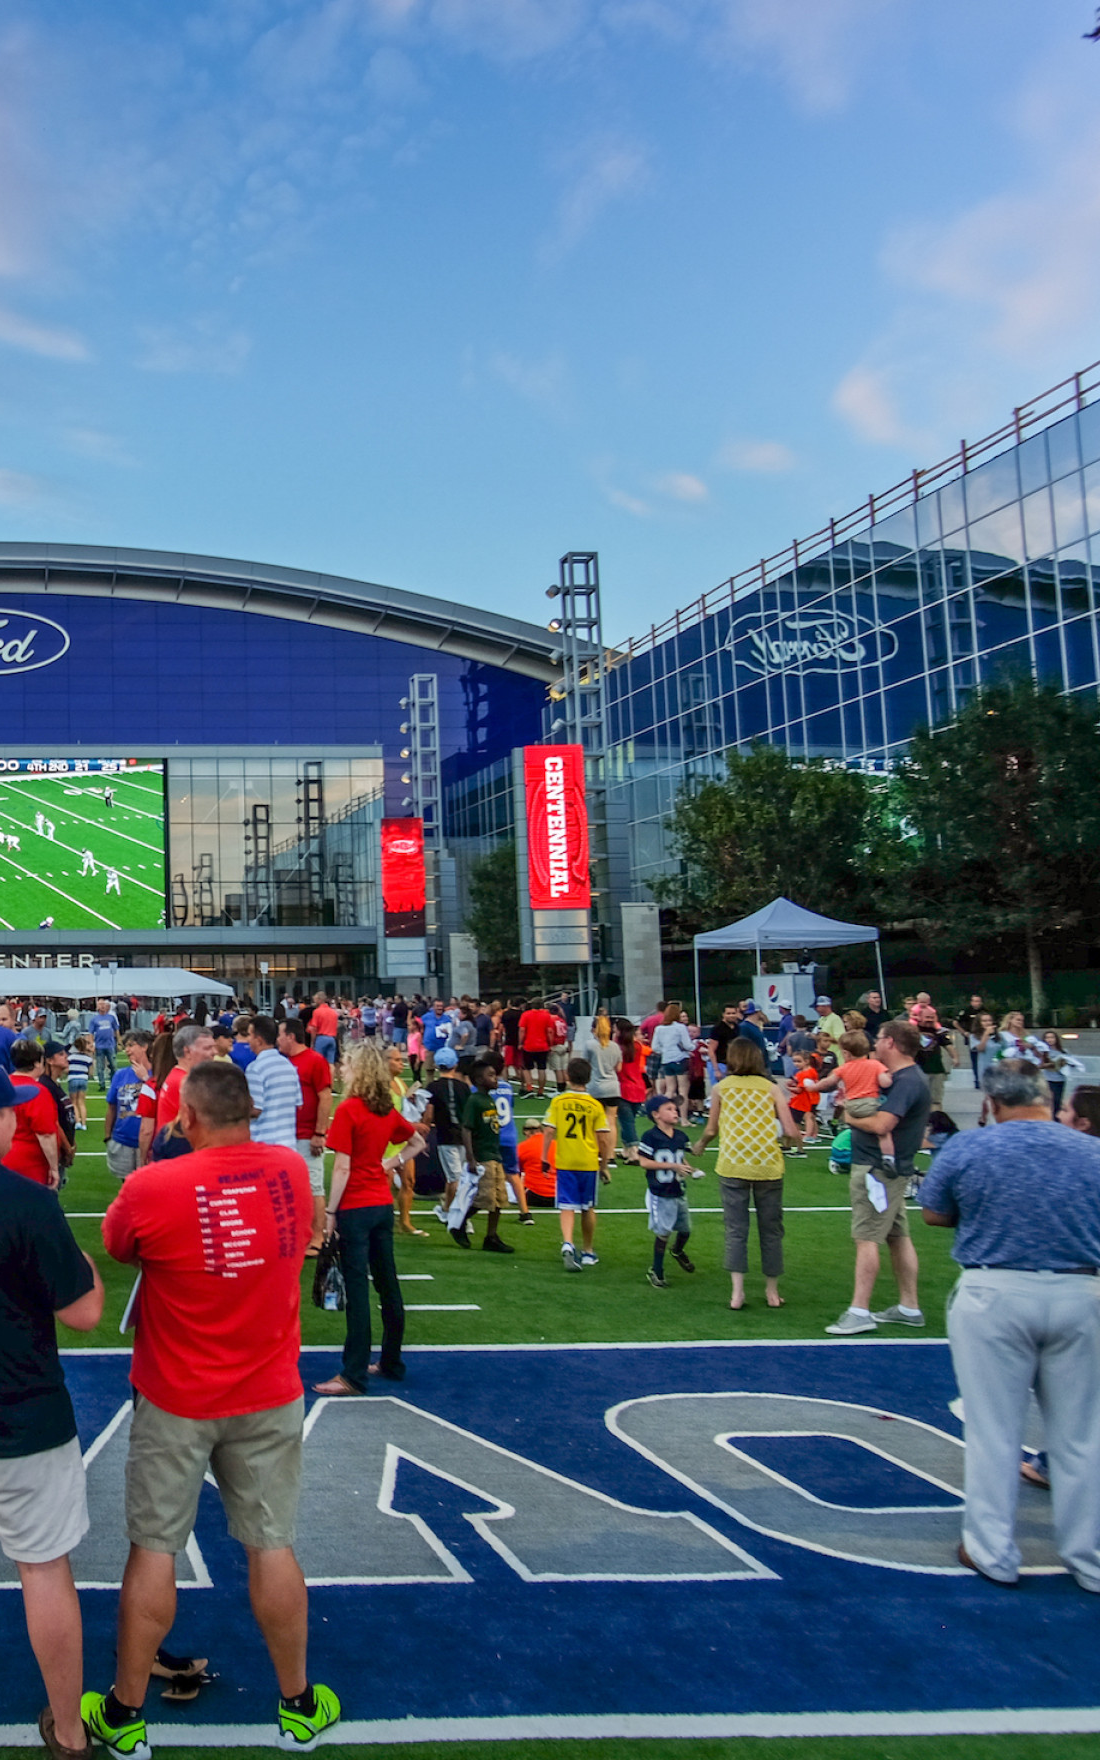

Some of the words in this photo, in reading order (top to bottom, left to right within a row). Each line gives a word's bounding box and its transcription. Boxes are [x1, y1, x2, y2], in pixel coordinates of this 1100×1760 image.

[48, 763, 69, 772] 2ND
[544, 756, 569, 898] CENTENNIAL
[495, 1097, 511, 1126] 9
[565, 1112, 586, 1140] 21
